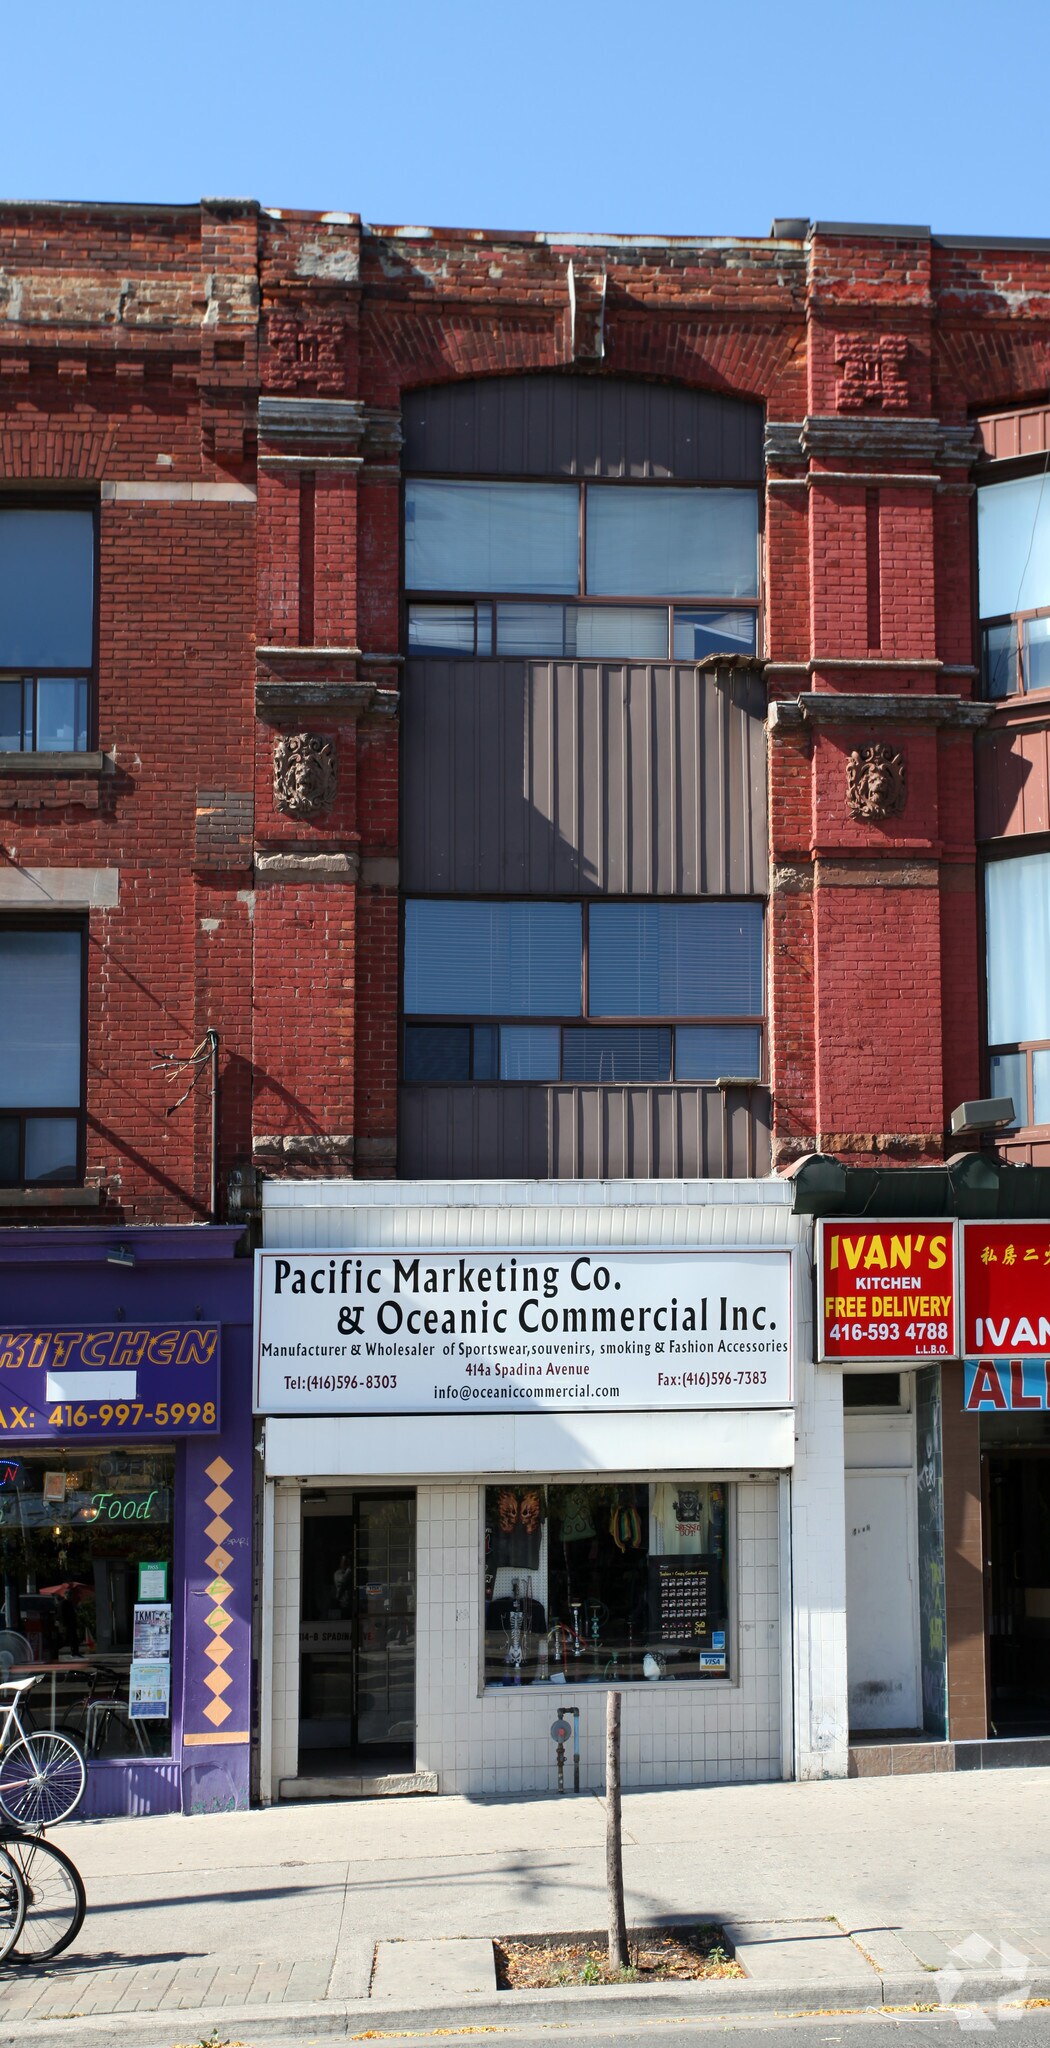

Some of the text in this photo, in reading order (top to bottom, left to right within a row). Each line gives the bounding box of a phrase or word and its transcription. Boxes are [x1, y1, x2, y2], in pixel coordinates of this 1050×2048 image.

[830, 1234, 947, 1270] IVAN'S
[274, 1256, 622, 1298] Pacific Marketing Co.
[855, 1276, 922, 1290] KITCHEN
[337, 1296, 777, 1335] & Oceanic Commercial Inc.
[825, 1295, 952, 1318] FREE DELIVERY
[829, 1322, 948, 1341] 416-593 4788
[0, 1330, 218, 1368] KITCHEN
[261, 1343, 347, 1357] Manufacturer
[350, 1344, 362, 1356] &
[365, 1342, 435, 1356] Wholesaler
[442, 1342, 456, 1356] of
[600, 1340, 652, 1356] smoking
[654, 1342, 665, 1354] &
[669, 1340, 714, 1354] Fashion
[717, 1339, 788, 1353] Accessories
[915, 1344, 949, 1355] L.L.B.O.
[465, 1362, 590, 1379] 414a Spadina Avenue
[657, 1371, 768, 1388] Fax:(416)596-7383
[284, 1375, 398, 1392] Tel:(416)596-8303
[434, 1384, 620, 1401] info@oceaniccommercial.com
[966, 1359, 1050, 1411] AL
[48, 1402, 216, 1427] 416-997-5998
[86, 1490, 159, 1523] Food
